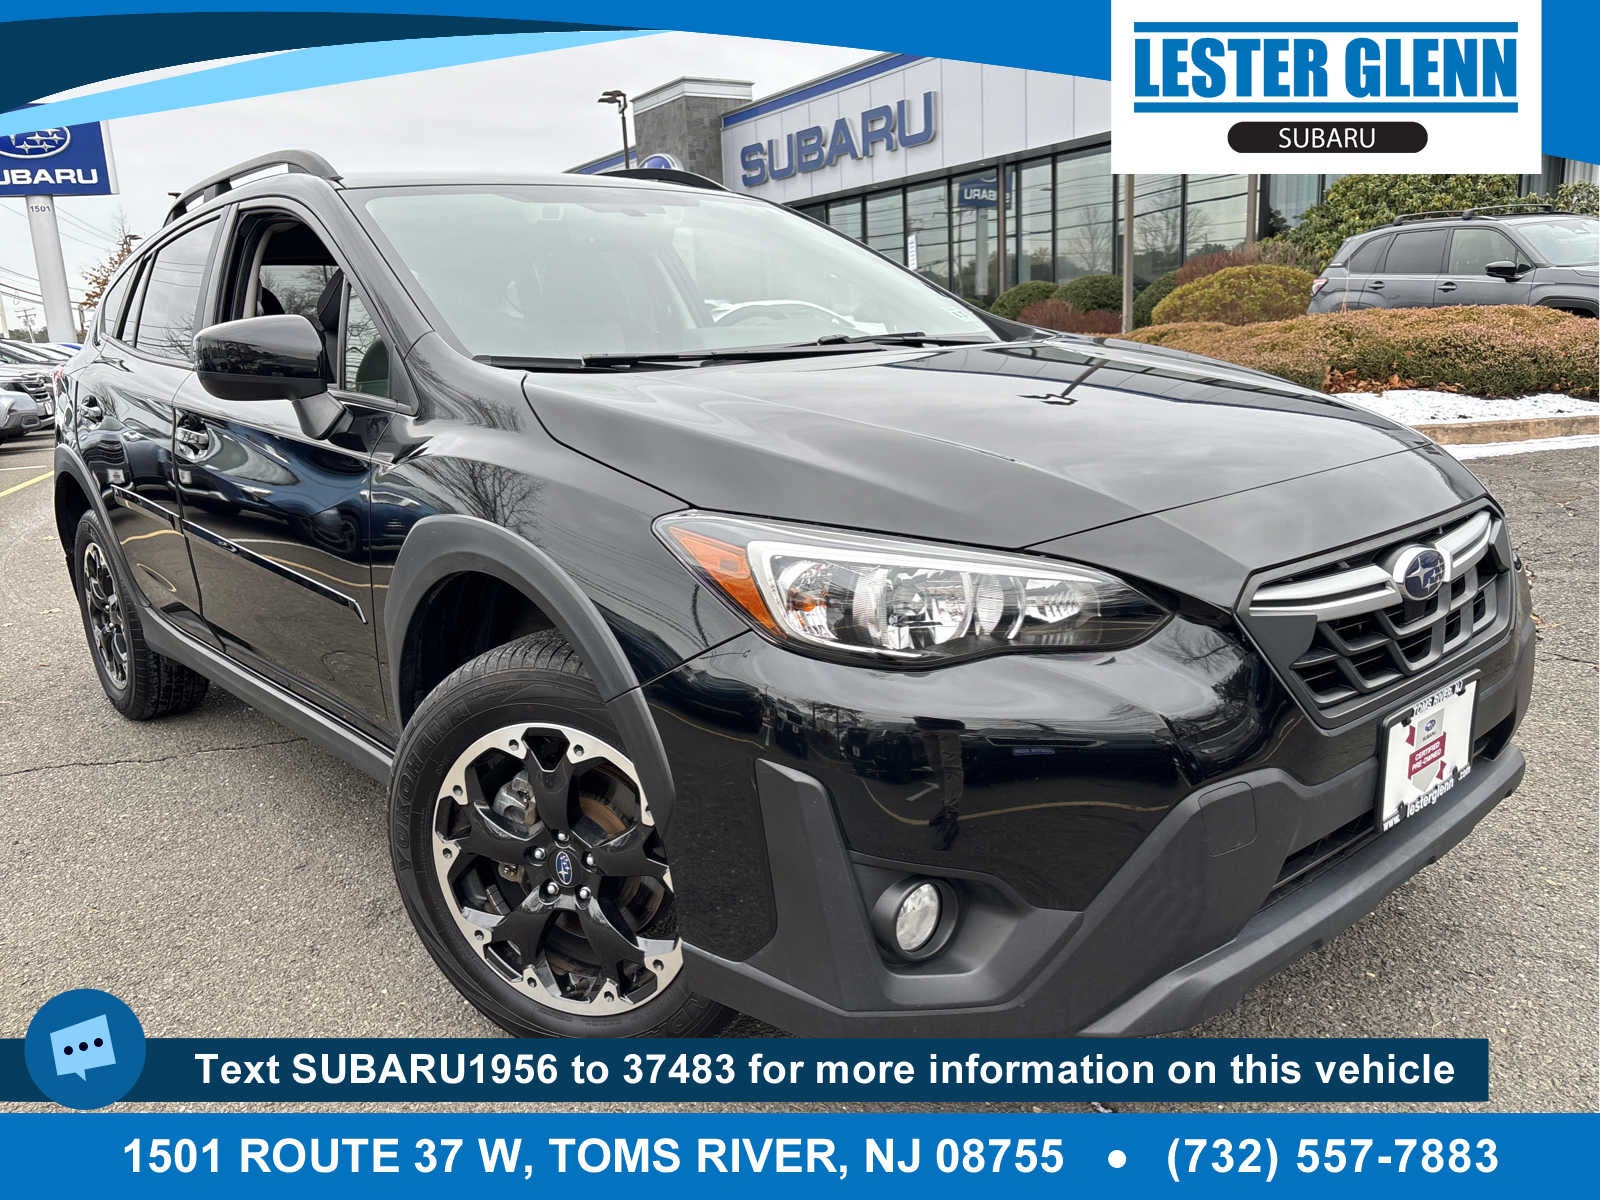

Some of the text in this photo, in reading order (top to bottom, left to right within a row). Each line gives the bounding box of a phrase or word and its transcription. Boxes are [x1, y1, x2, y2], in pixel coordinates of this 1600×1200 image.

[740, 91, 935, 188] SUBARU
[0, 168, 98, 185] UBARU
[31, 205, 51, 213] 1501
[1411, 748, 1442, 772] PRE-OWNED
[1414, 741, 1440, 760] CERTIFIED
